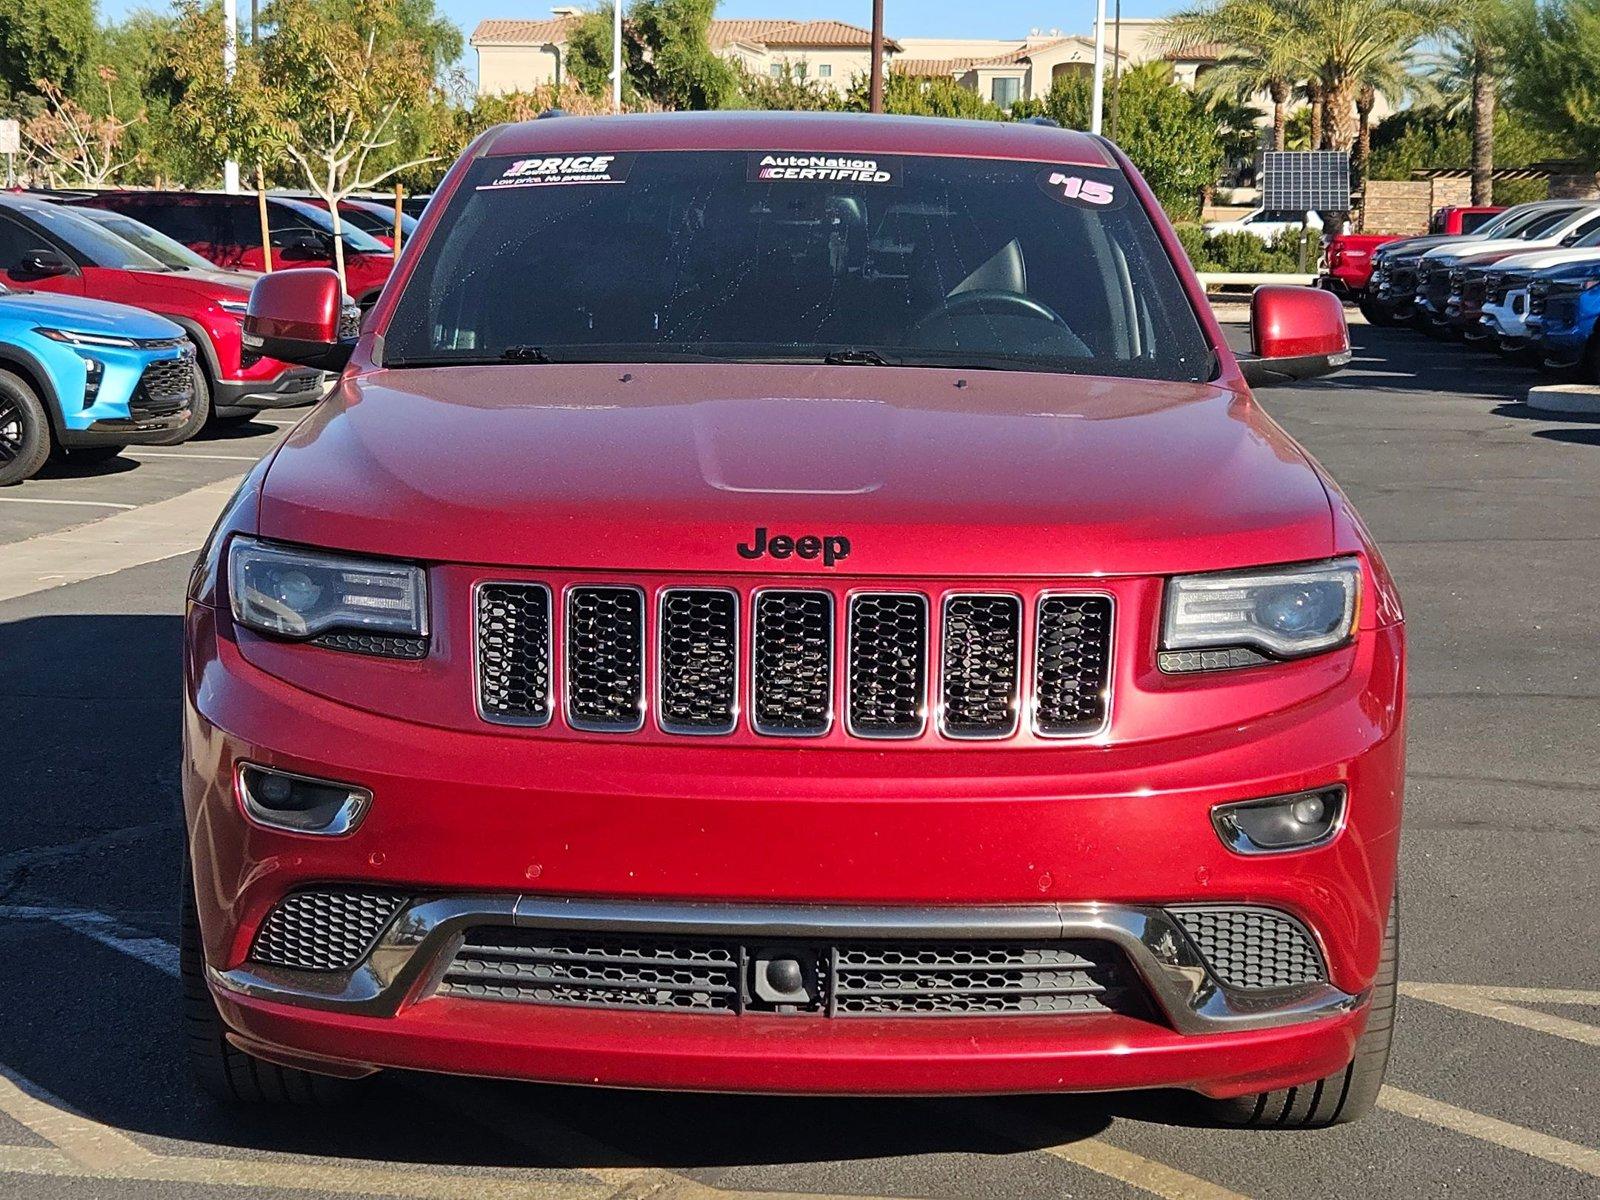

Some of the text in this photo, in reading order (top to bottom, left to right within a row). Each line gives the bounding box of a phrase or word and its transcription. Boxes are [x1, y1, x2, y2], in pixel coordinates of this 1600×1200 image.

[760, 156, 877, 169] AutoNation
[492, 178, 514, 186] Low
[544, 174, 560, 182] No
[762, 168, 891, 182] CERTIFIED
[1048, 172, 1114, 205] '15
[737, 527, 851, 566] Jeep
